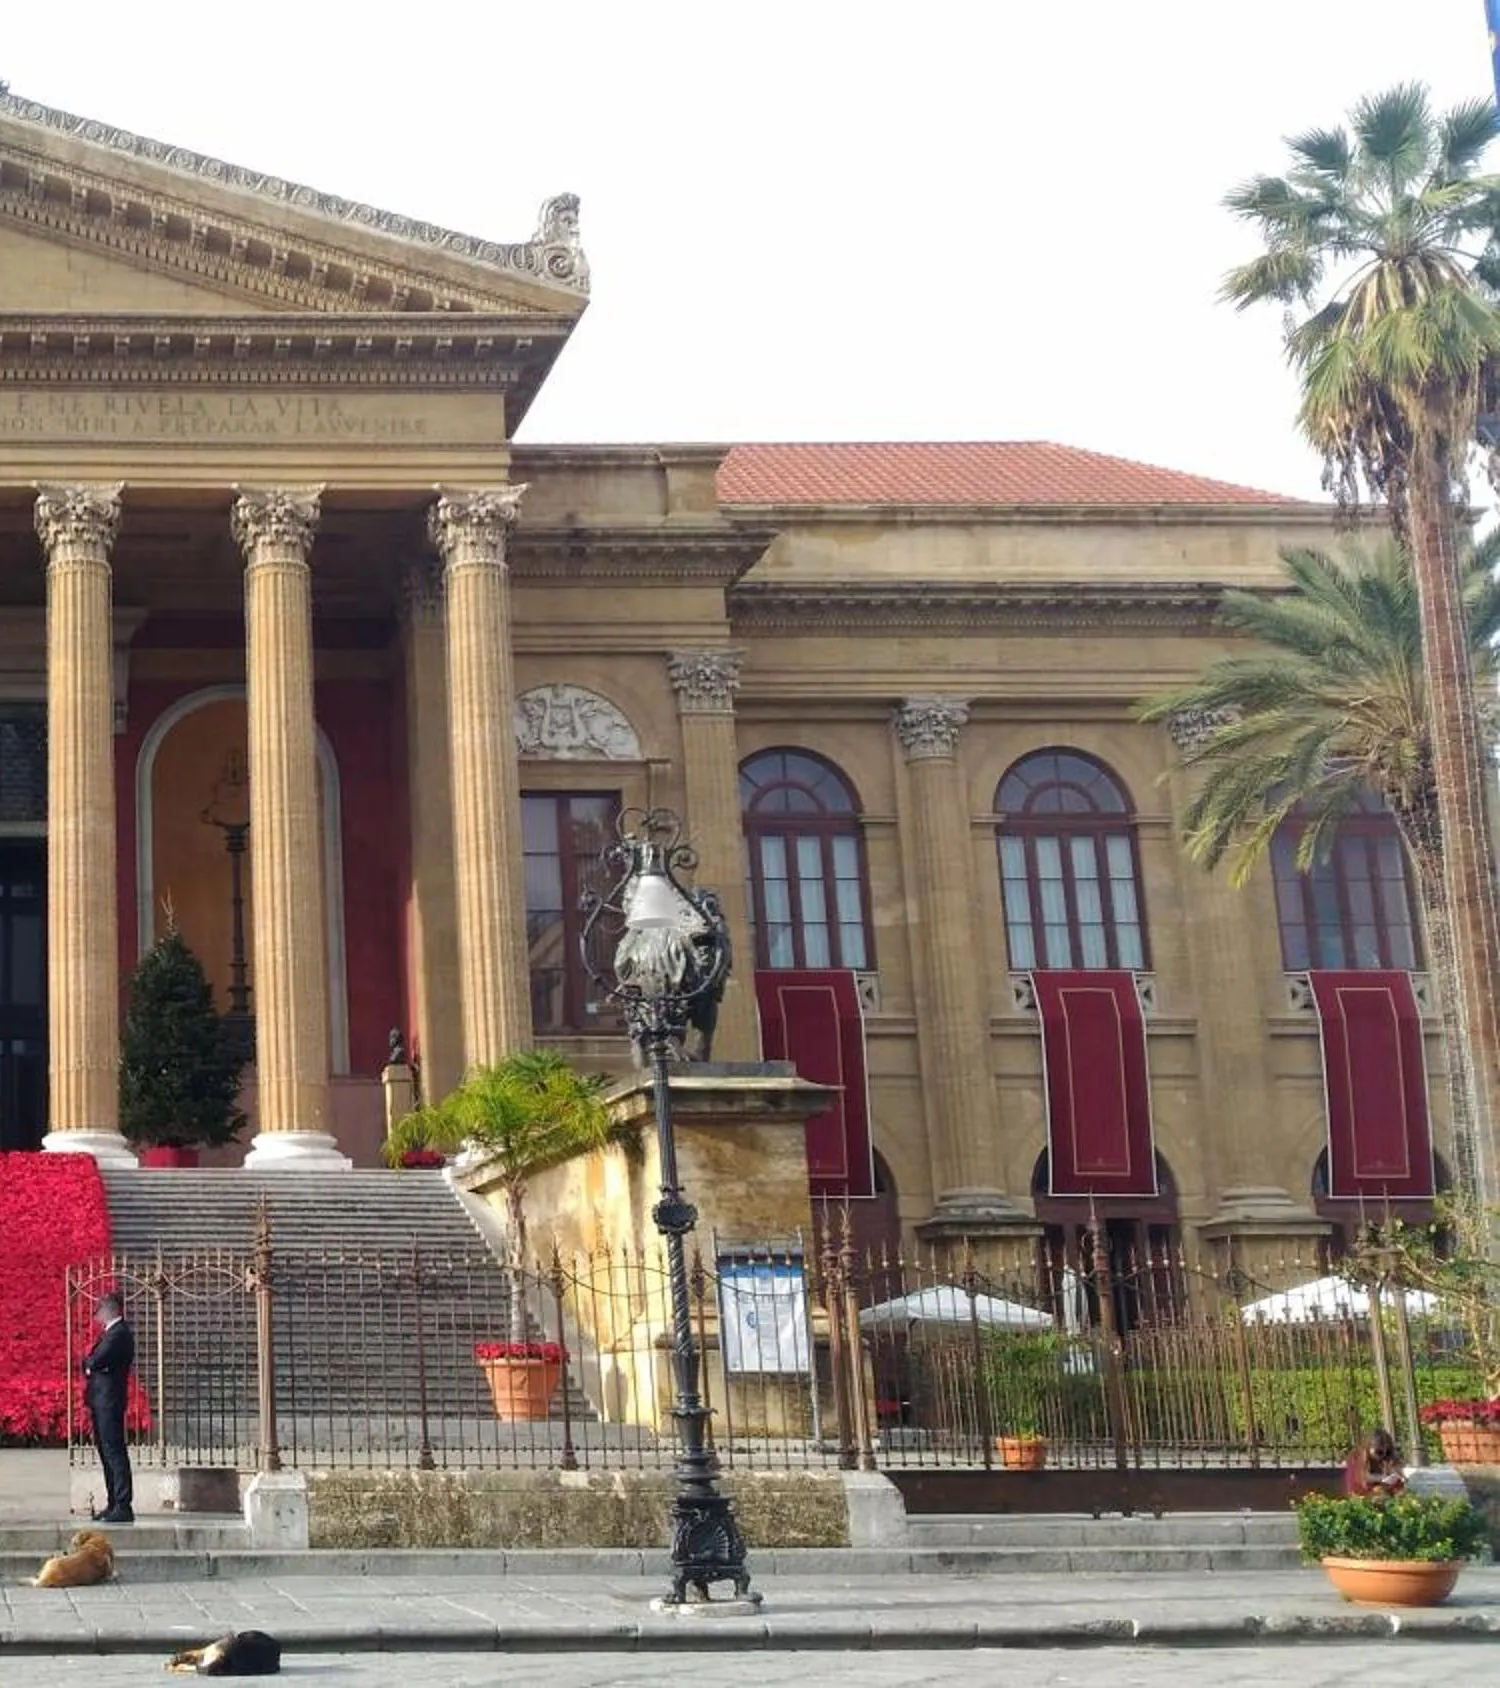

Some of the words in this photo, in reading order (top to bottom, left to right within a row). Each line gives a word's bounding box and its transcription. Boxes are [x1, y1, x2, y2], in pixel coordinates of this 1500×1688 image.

[49, 395, 86, 416] NE
[104, 396, 208, 417] RIVELA
[229, 396, 258, 417] LA
[273, 396, 344, 418] VITA
